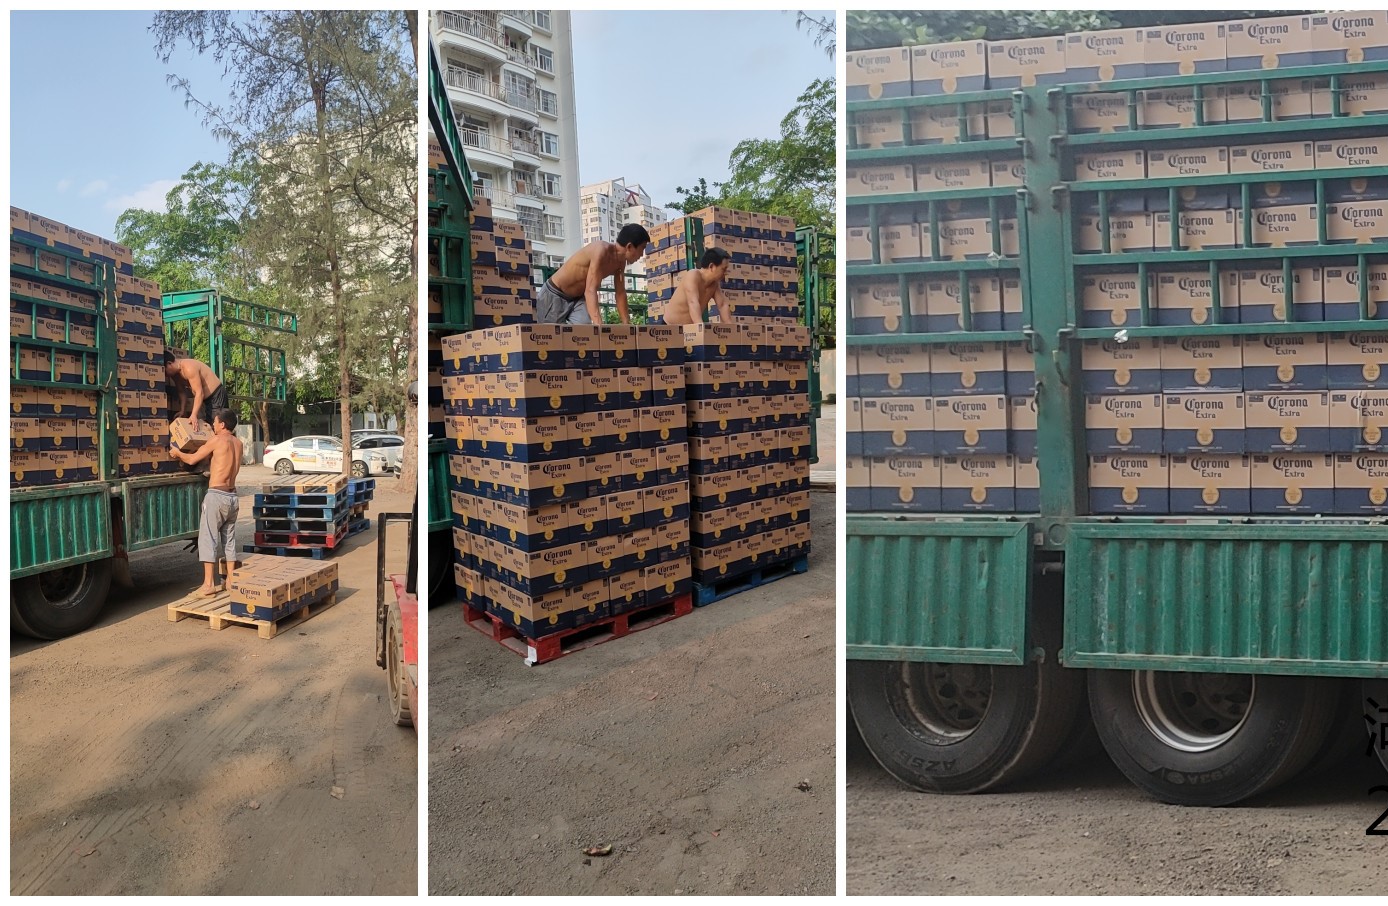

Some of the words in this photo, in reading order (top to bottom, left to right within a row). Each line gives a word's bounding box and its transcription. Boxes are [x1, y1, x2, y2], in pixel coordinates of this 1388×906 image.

[1332, 17, 1374, 33] Corona
[1247, 24, 1288, 41] Corona
[1344, 29, 1366, 38] Extra
[1165, 31, 1205, 48] Corona
[1260, 36, 1281, 45] Extra
[1177, 43, 1197, 51] Extra
[1336, 144, 1378, 161] Corona
[1166, 151, 1207, 167] Corona
[1348, 157, 1370, 165] Extra
[1179, 166, 1199, 174] Extra
[1342, 207, 1383, 224] Corona
[1354, 219, 1375, 228] Extra
[529, 333, 552, 344] Corona
[649, 328, 672, 340] Corona
[1361, 344, 1382, 353] Extra
[539, 373, 568, 384] Corona
[880, 402, 915, 415] Corona
[952, 401, 987, 417] Corona
[1105, 398, 1142, 414] Corona
[1185, 398, 1223, 415] Corona
[1268, 396, 1308, 413] Corona
[653, 410, 675, 419] Corona
[890, 413, 908, 421] Extra
[962, 412, 980, 420] Extra
[1115, 410, 1134, 418] Extra
[1198, 410, 1218, 420] Extra
[1279, 408, 1300, 417] Extra
[1362, 407, 1383, 417] Extra
[889, 456, 923, 470] Corona
[960, 457, 997, 471] Corona
[1110, 457, 1149, 472] Corona
[1190, 457, 1231, 472] Corona
[1271, 456, 1314, 471] Corona
[543, 464, 571, 476] Corona
[898, 469, 916, 477] Extra
[971, 469, 989, 477] Extra
[1121, 469, 1141, 477] Extra
[1202, 469, 1222, 478] Extra
[1284, 468, 1305, 477] Extra
[1368, 468, 1388, 477] Extra
[544, 549, 572, 562] Corona
